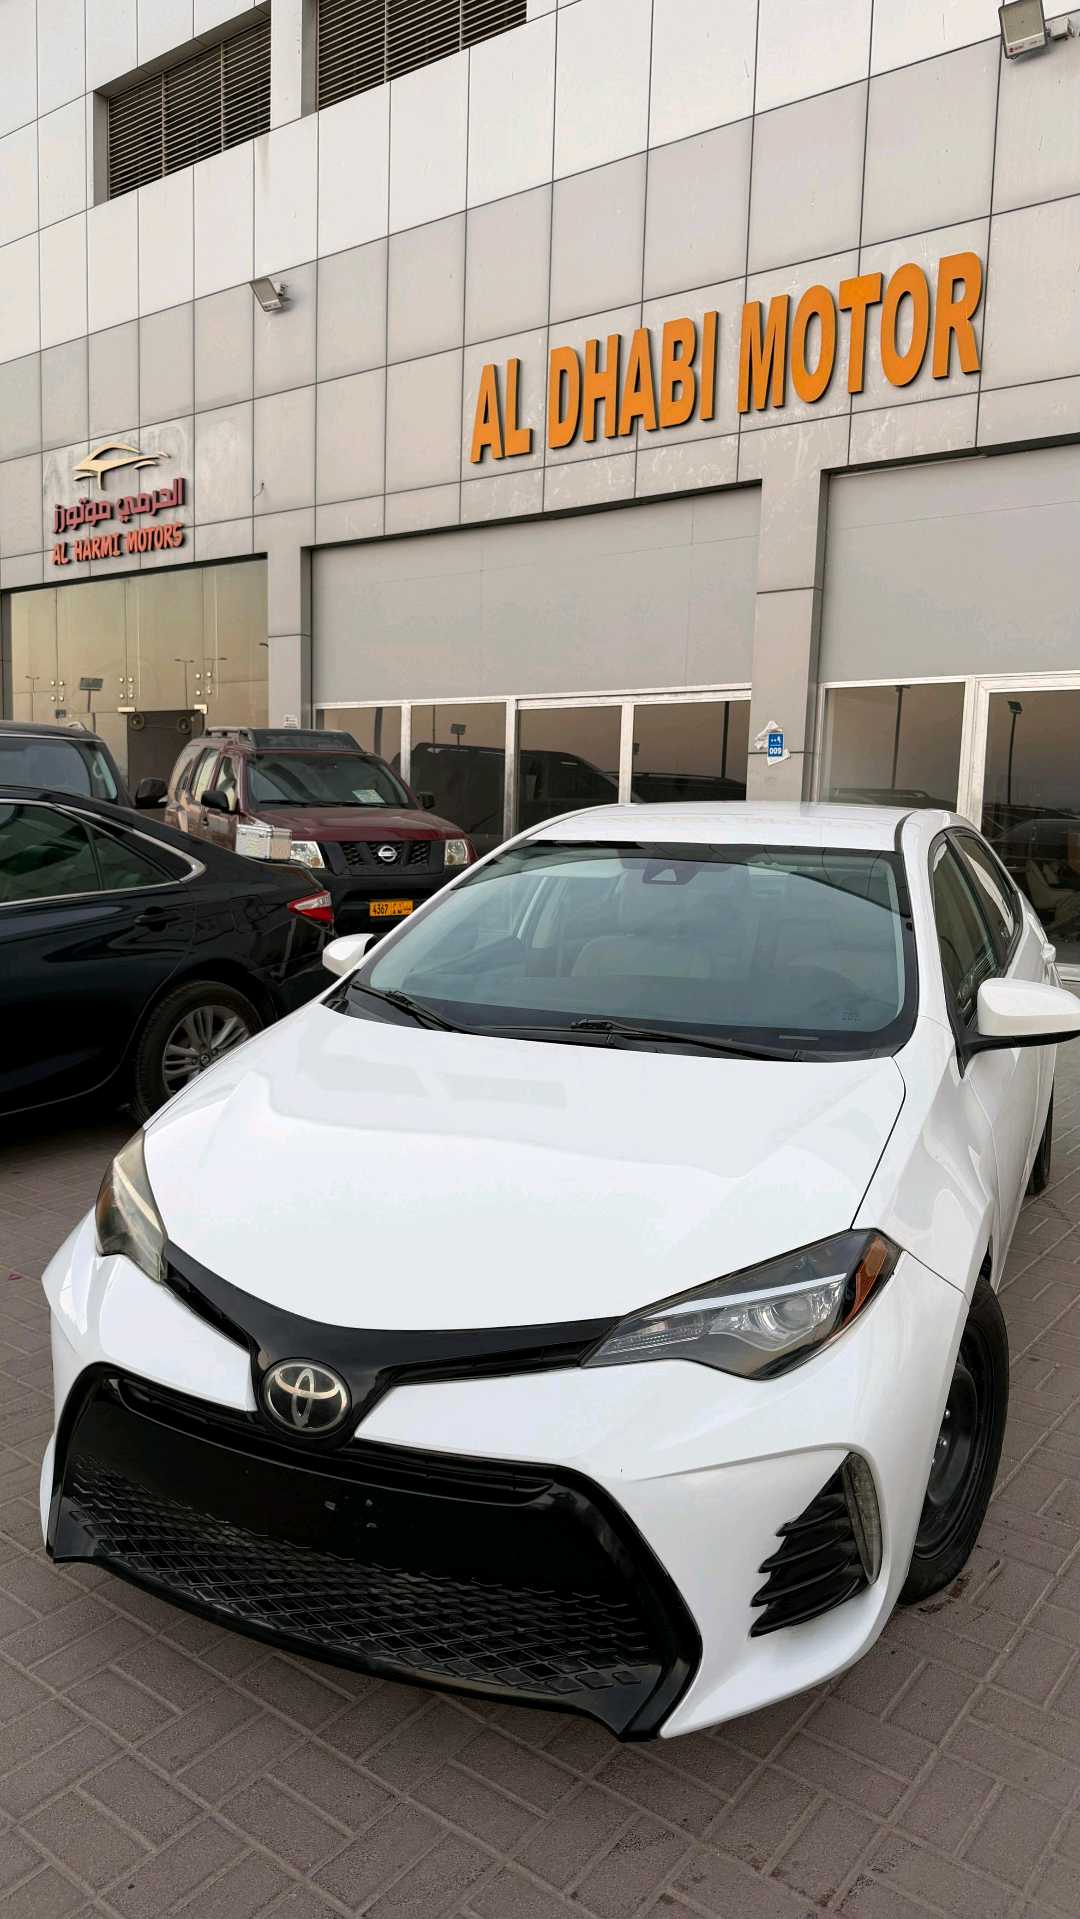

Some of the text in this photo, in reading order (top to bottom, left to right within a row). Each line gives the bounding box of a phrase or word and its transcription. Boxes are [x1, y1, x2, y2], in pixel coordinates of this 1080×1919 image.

[470, 251, 983, 464] AL DHABI MOTOR
[54, 497, 113, 533] موتورز
[52, 522, 184, 565] AL HARMI MOTORS
